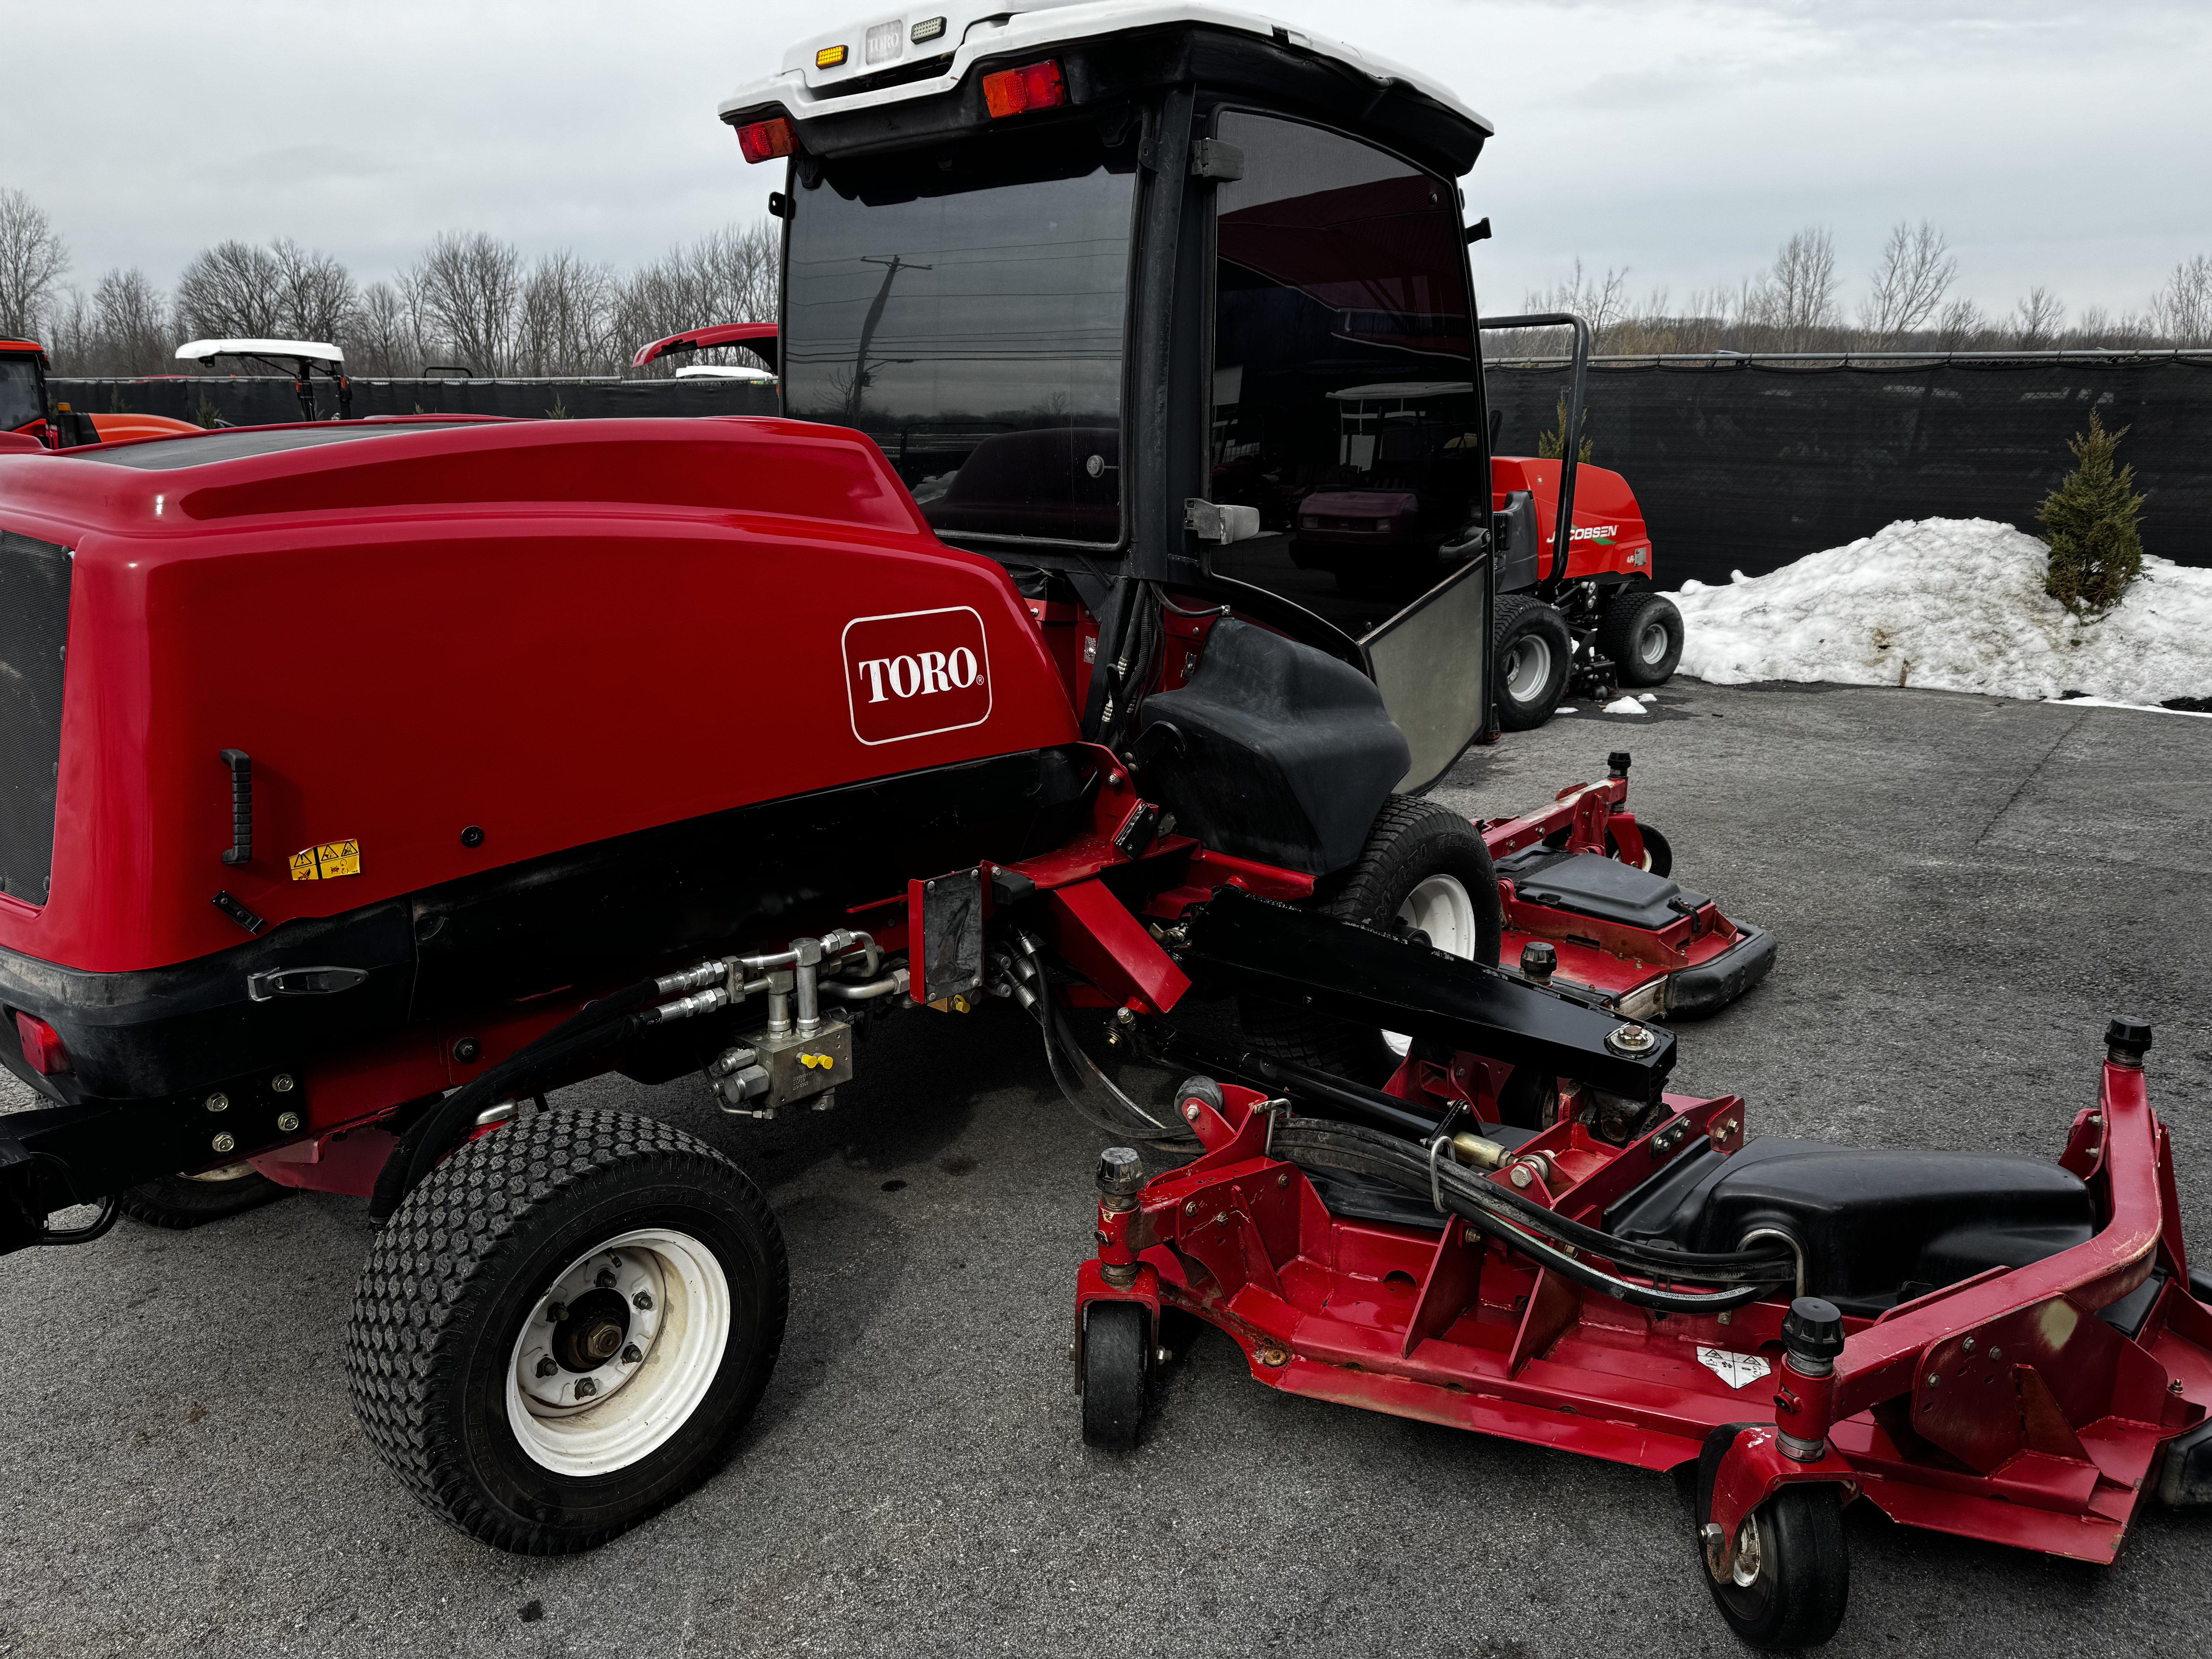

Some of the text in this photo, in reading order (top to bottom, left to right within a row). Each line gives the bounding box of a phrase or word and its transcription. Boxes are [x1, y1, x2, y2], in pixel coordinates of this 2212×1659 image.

[868, 33, 899, 53] TORO
[1546, 525, 1618, 543] JCOBSEN
[859, 647, 978, 703] TORO
[469, 1410, 500, 1481] SUPER
